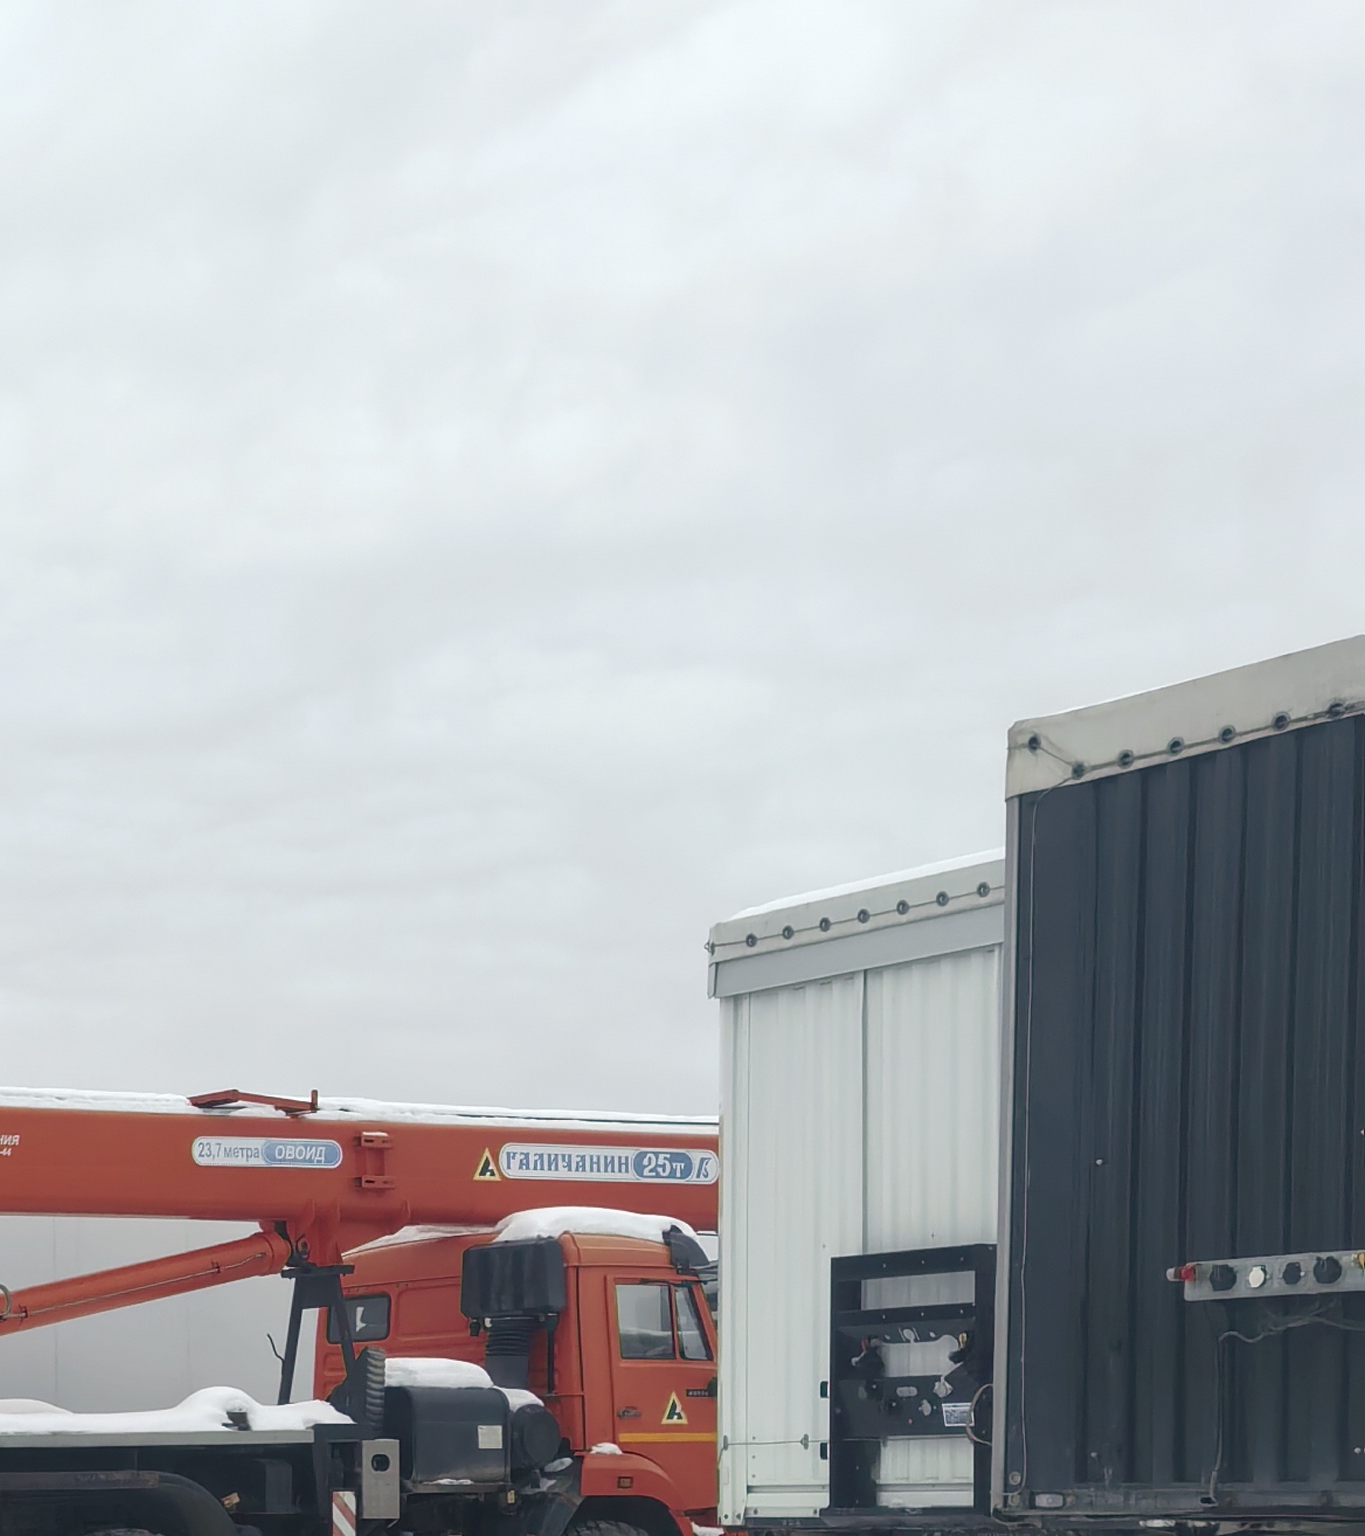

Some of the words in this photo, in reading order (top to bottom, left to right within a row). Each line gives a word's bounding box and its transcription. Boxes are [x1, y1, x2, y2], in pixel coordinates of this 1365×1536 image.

[198, 1142, 222, 1160] 23,7
[223, 1147, 260, 1162] метра
[275, 1145, 325, 1164] ОВОИД
[506, 1151, 630, 1174] ГАЛИЧАНИН
